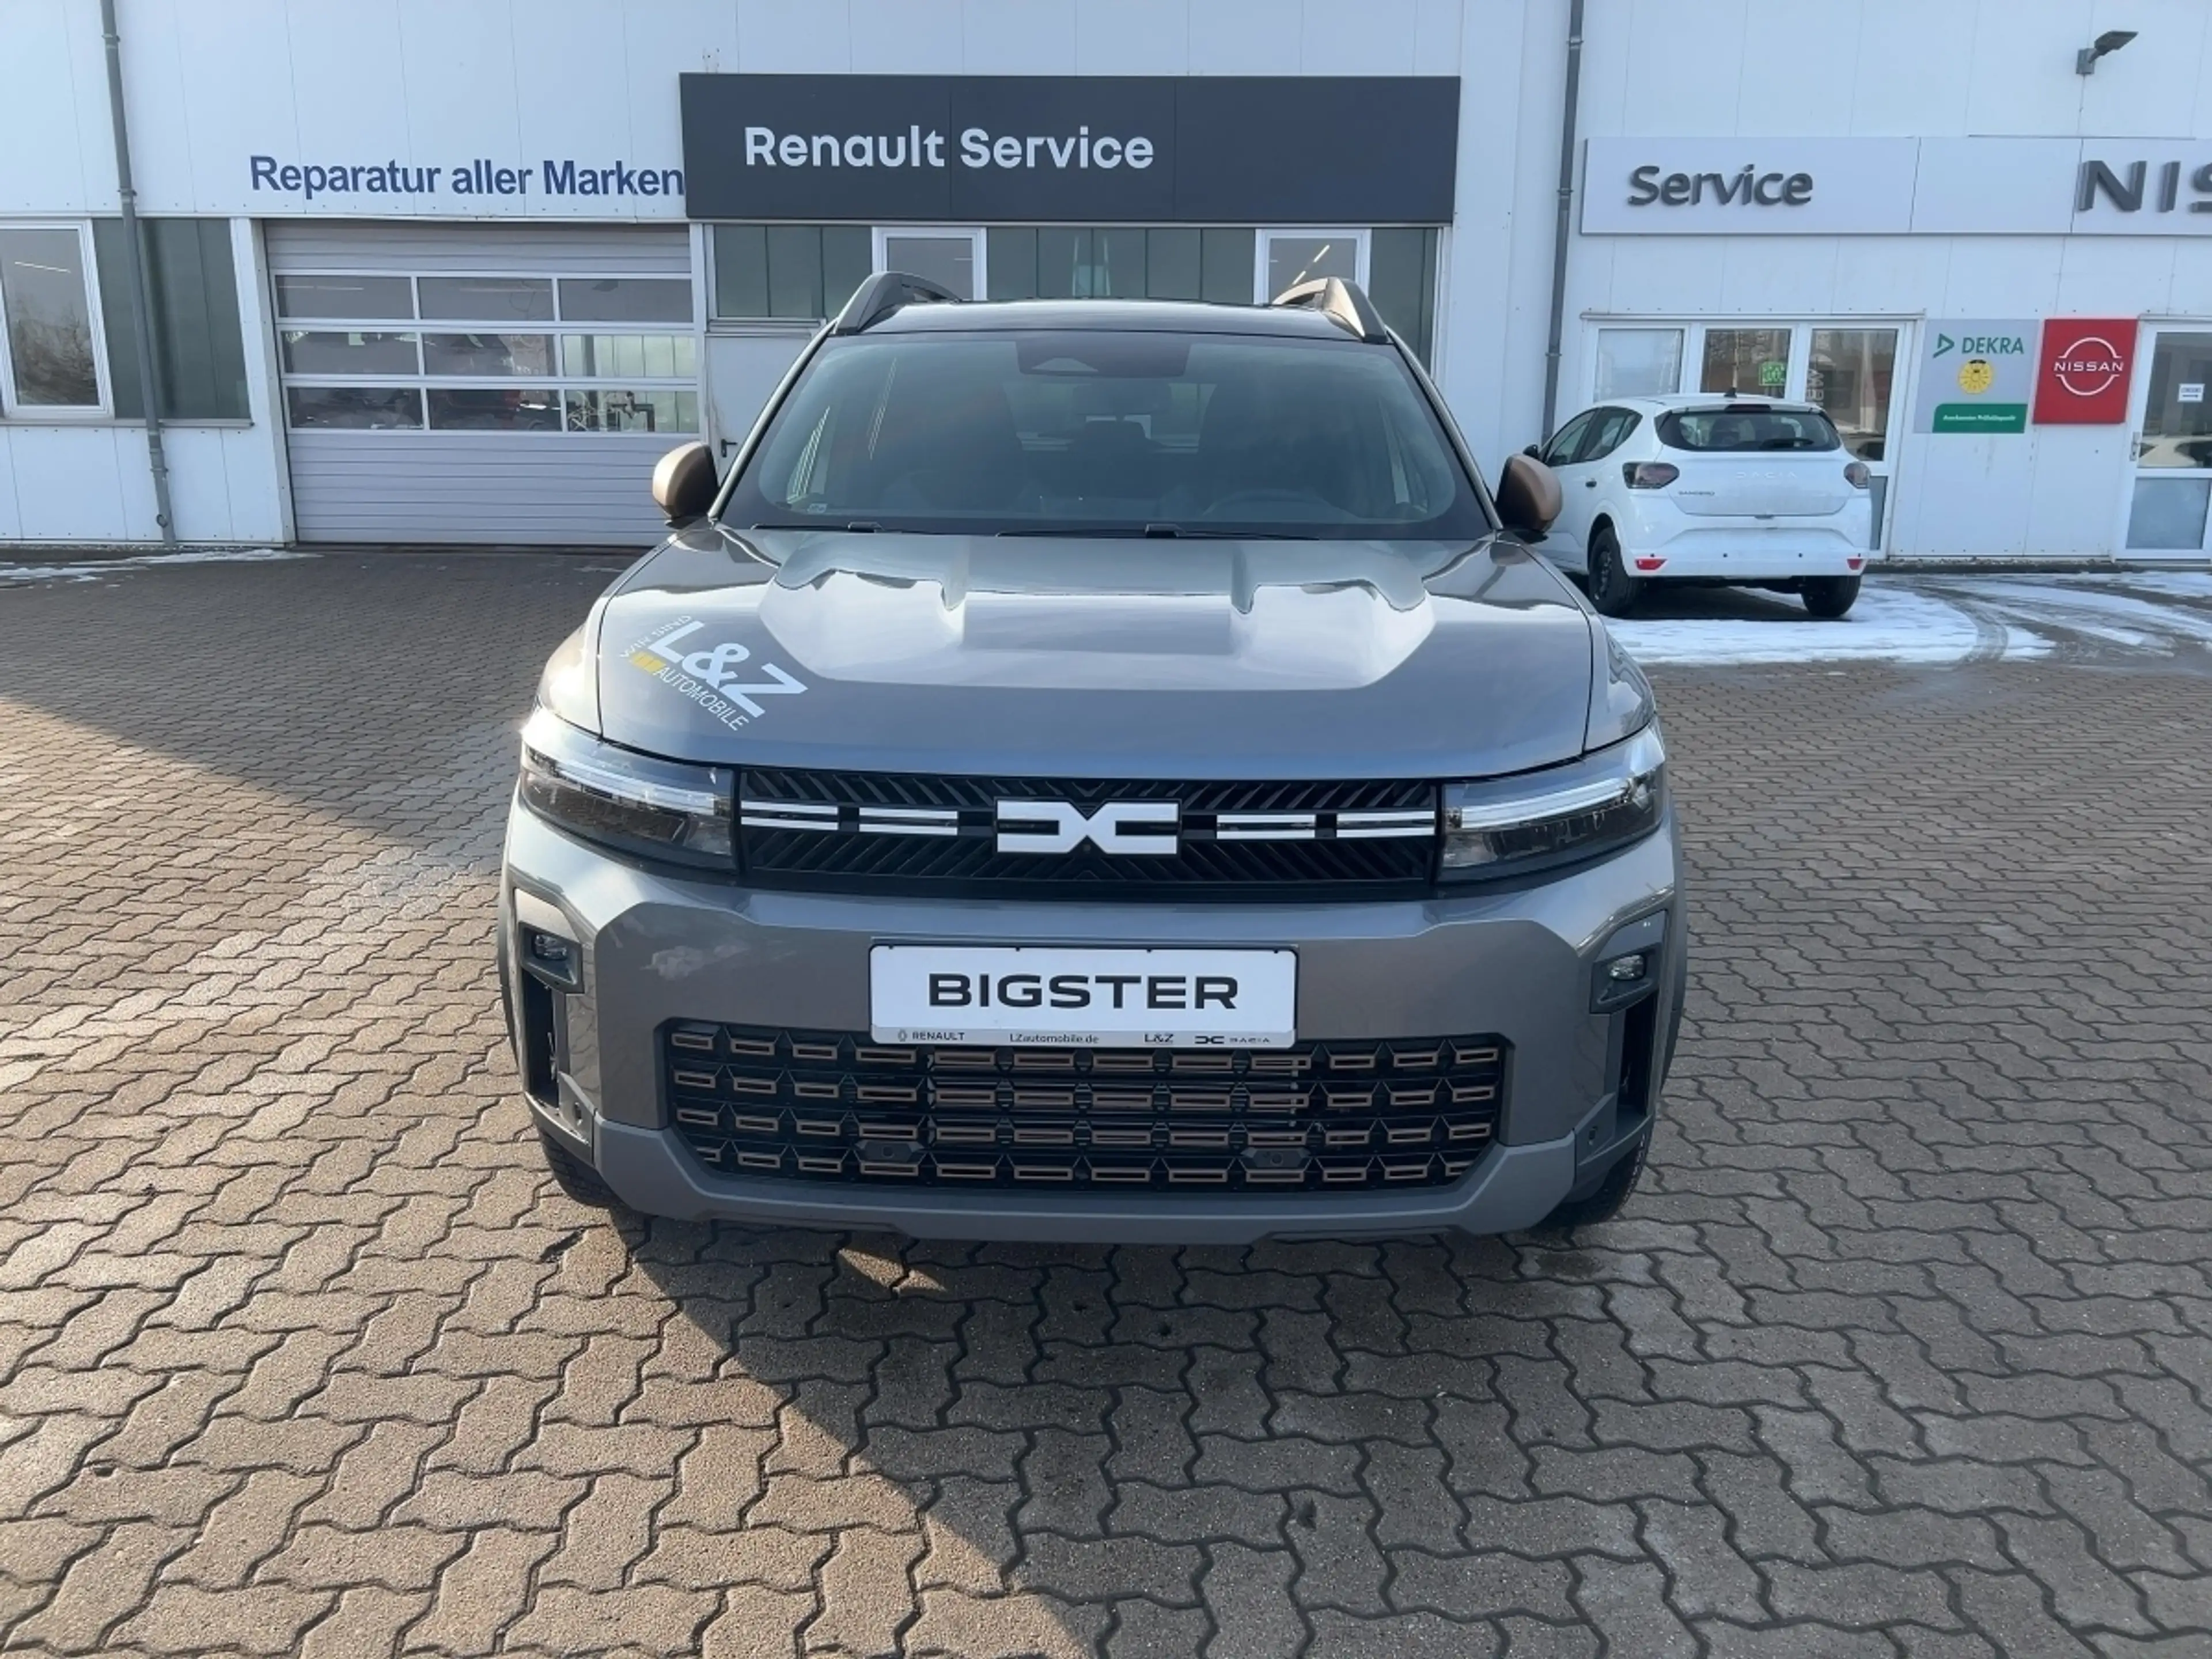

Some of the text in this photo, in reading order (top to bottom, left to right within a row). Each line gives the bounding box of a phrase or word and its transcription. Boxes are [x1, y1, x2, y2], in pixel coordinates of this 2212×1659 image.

[744, 124, 1154, 169] Renault Service
[249, 155, 684, 199] Reparatur aller Marken
[1627, 164, 1813, 206] Service
[1961, 336, 2024, 354] DEKRA
[2053, 361, 2124, 372] NISSAN
[647, 620, 808, 718] L&Z
[652, 667, 749, 731] AUTOMOBILE
[929, 973, 1238, 1009] BIGSTER
[912, 1032, 965, 1041] RENAULT
[1010, 1033, 1099, 1044] LZautomobile.de
[1144, 1033, 1174, 1043] L&Z
